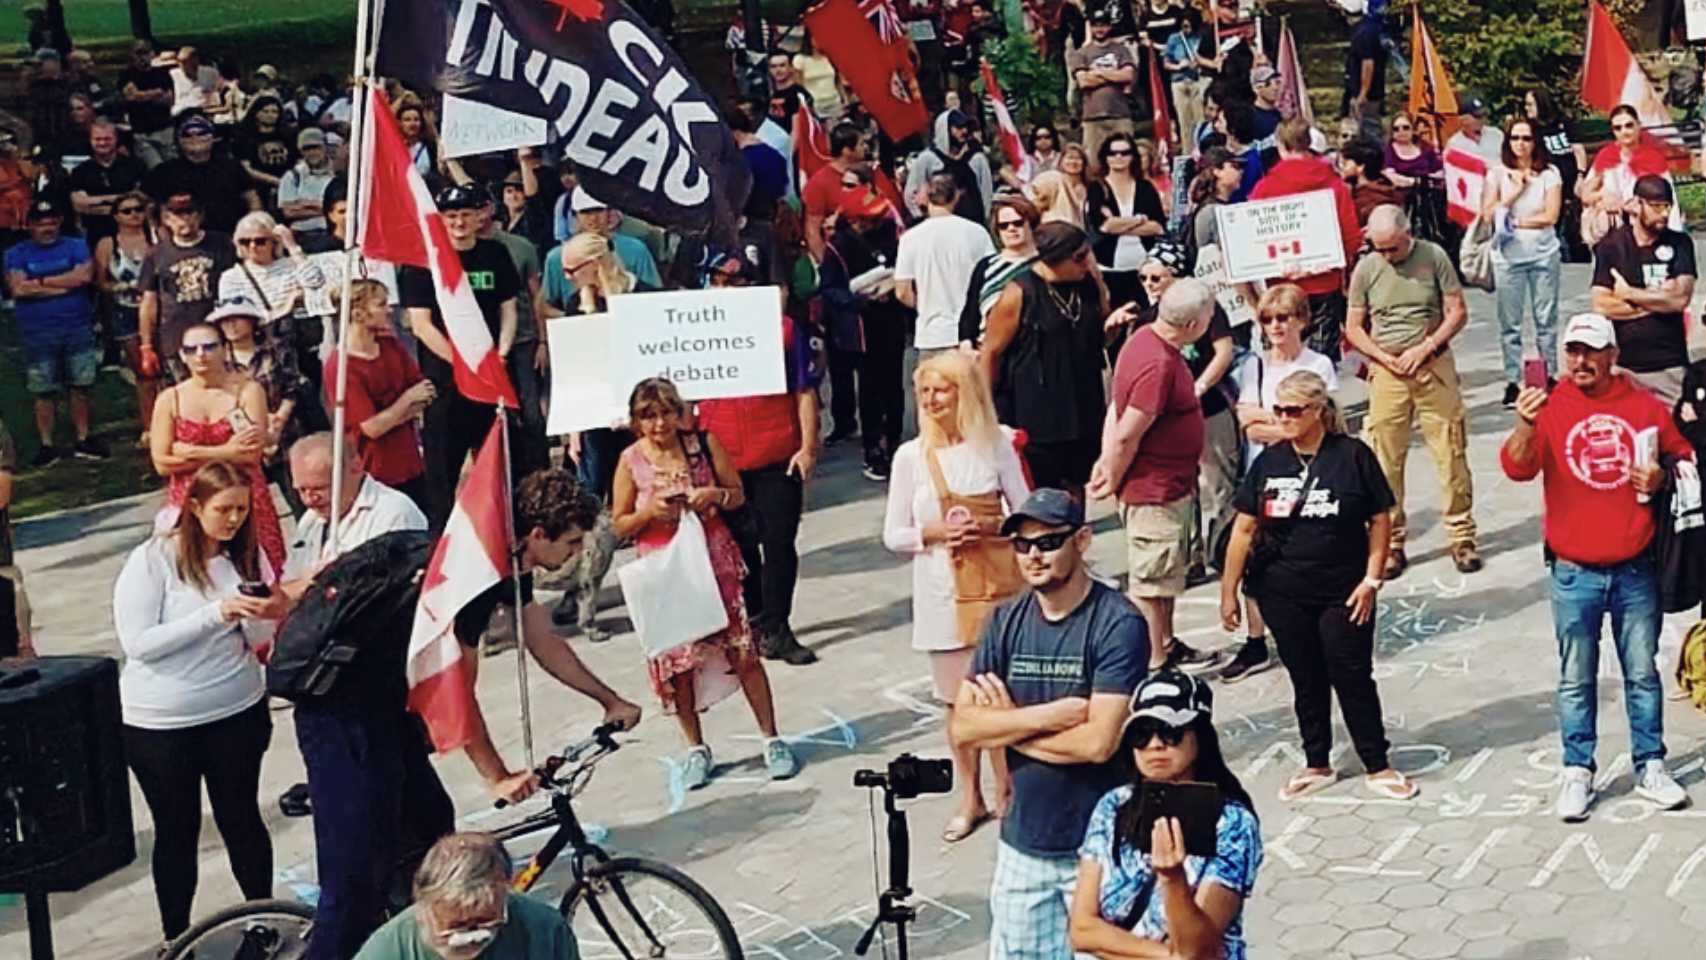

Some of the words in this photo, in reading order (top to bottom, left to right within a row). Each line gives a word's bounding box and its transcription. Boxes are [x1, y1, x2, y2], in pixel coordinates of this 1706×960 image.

[1256, 222, 1301, 236] HISTORY
[664, 305, 727, 325] Truth
[637, 334, 756, 356] welcomes
[656, 363, 740, 383] debate
